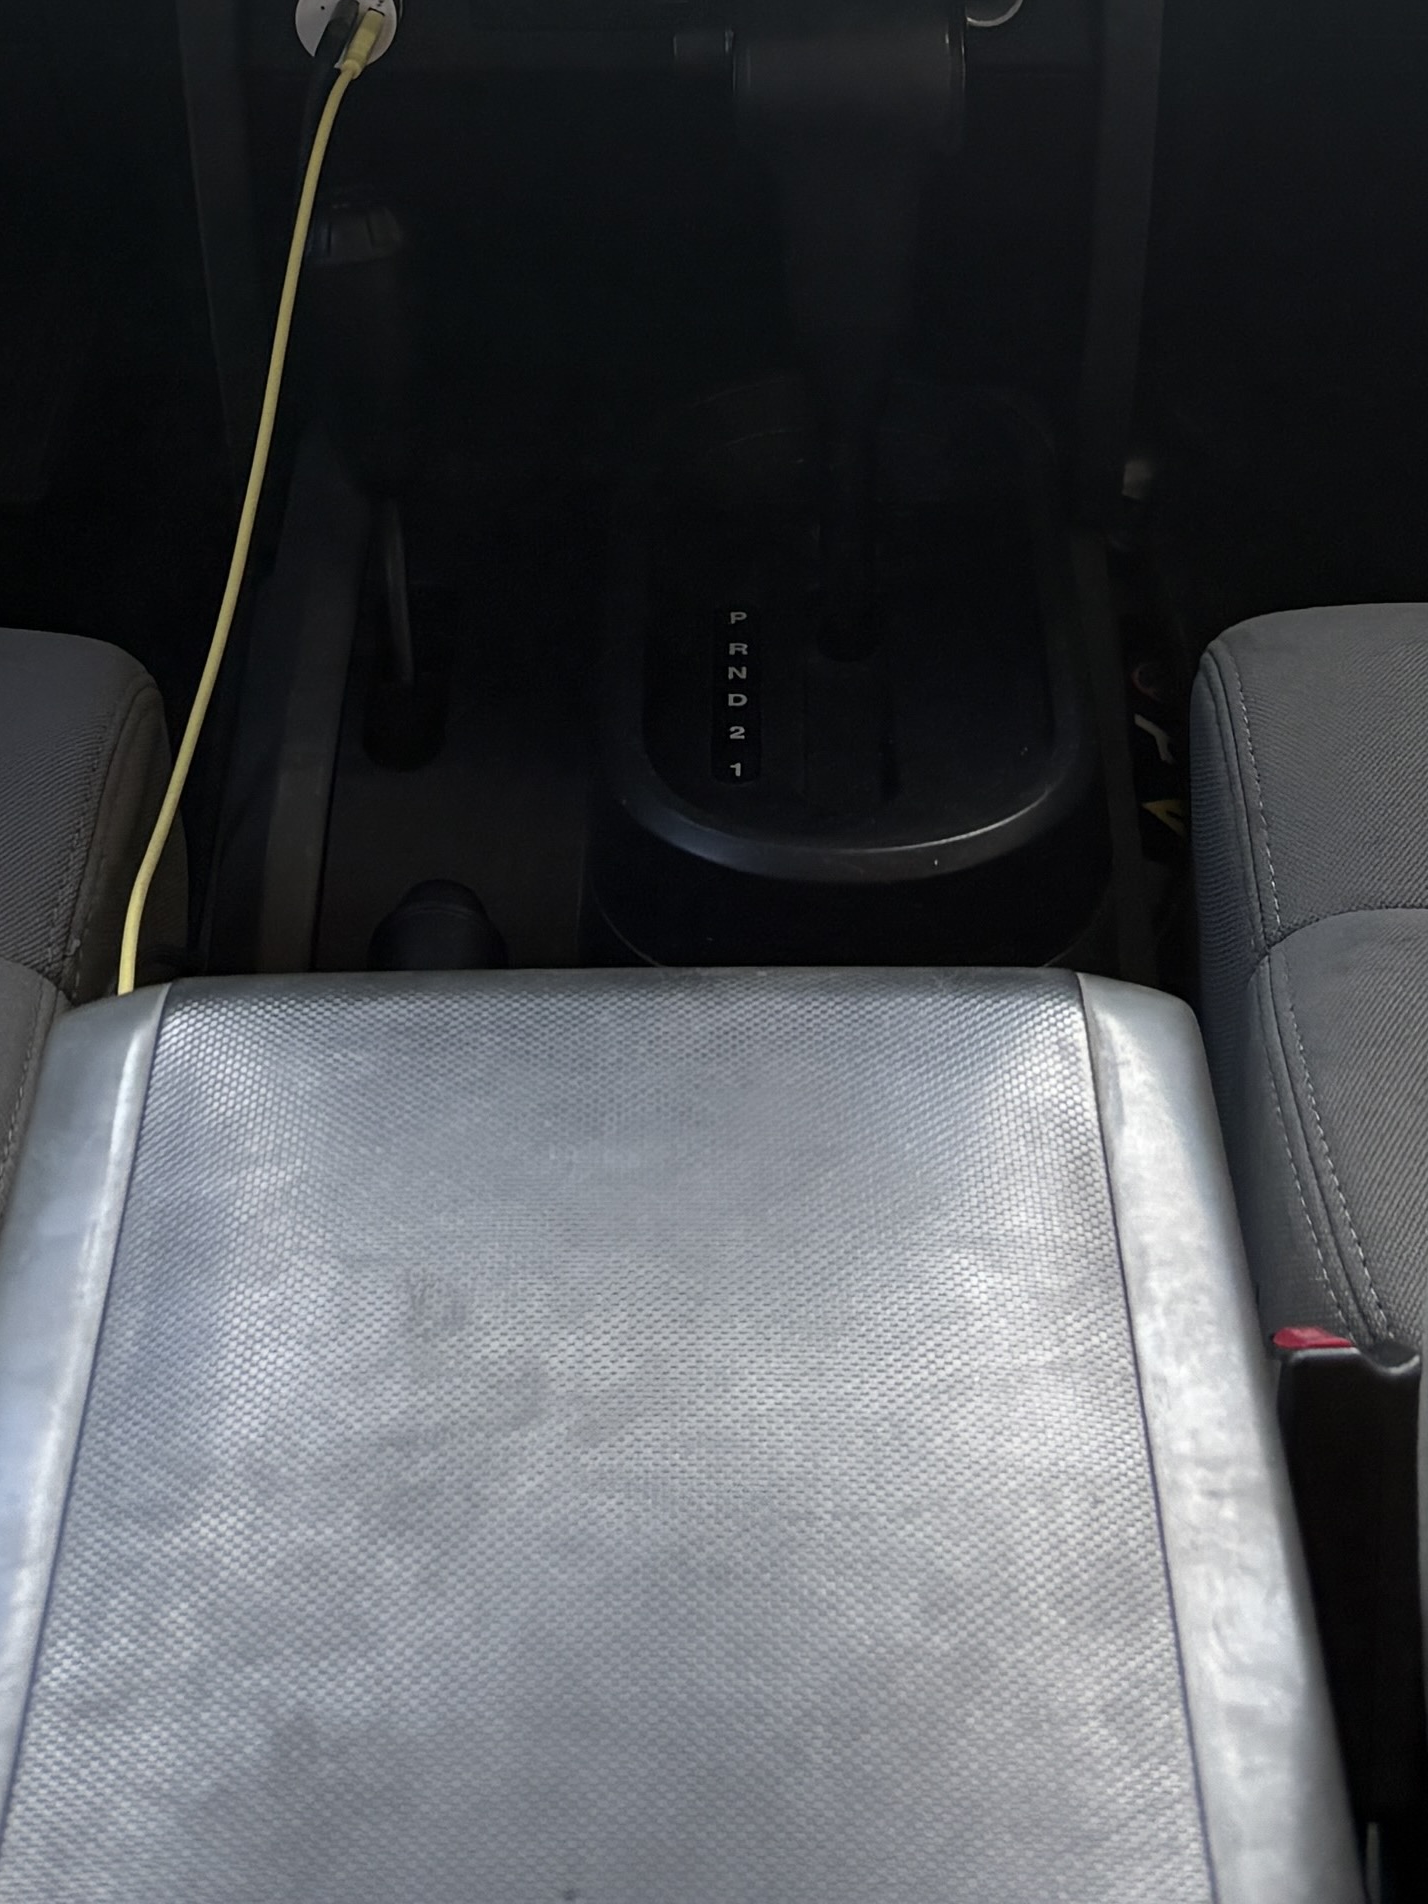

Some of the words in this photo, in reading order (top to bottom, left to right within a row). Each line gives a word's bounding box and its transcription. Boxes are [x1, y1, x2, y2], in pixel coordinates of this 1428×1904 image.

[730, 611, 747, 624] P
[728, 643, 748, 656] R
[728, 666, 747, 680] N
[728, 693, 748, 707] D
[729, 725, 746, 740] 2
[729, 762, 742, 777] 1
